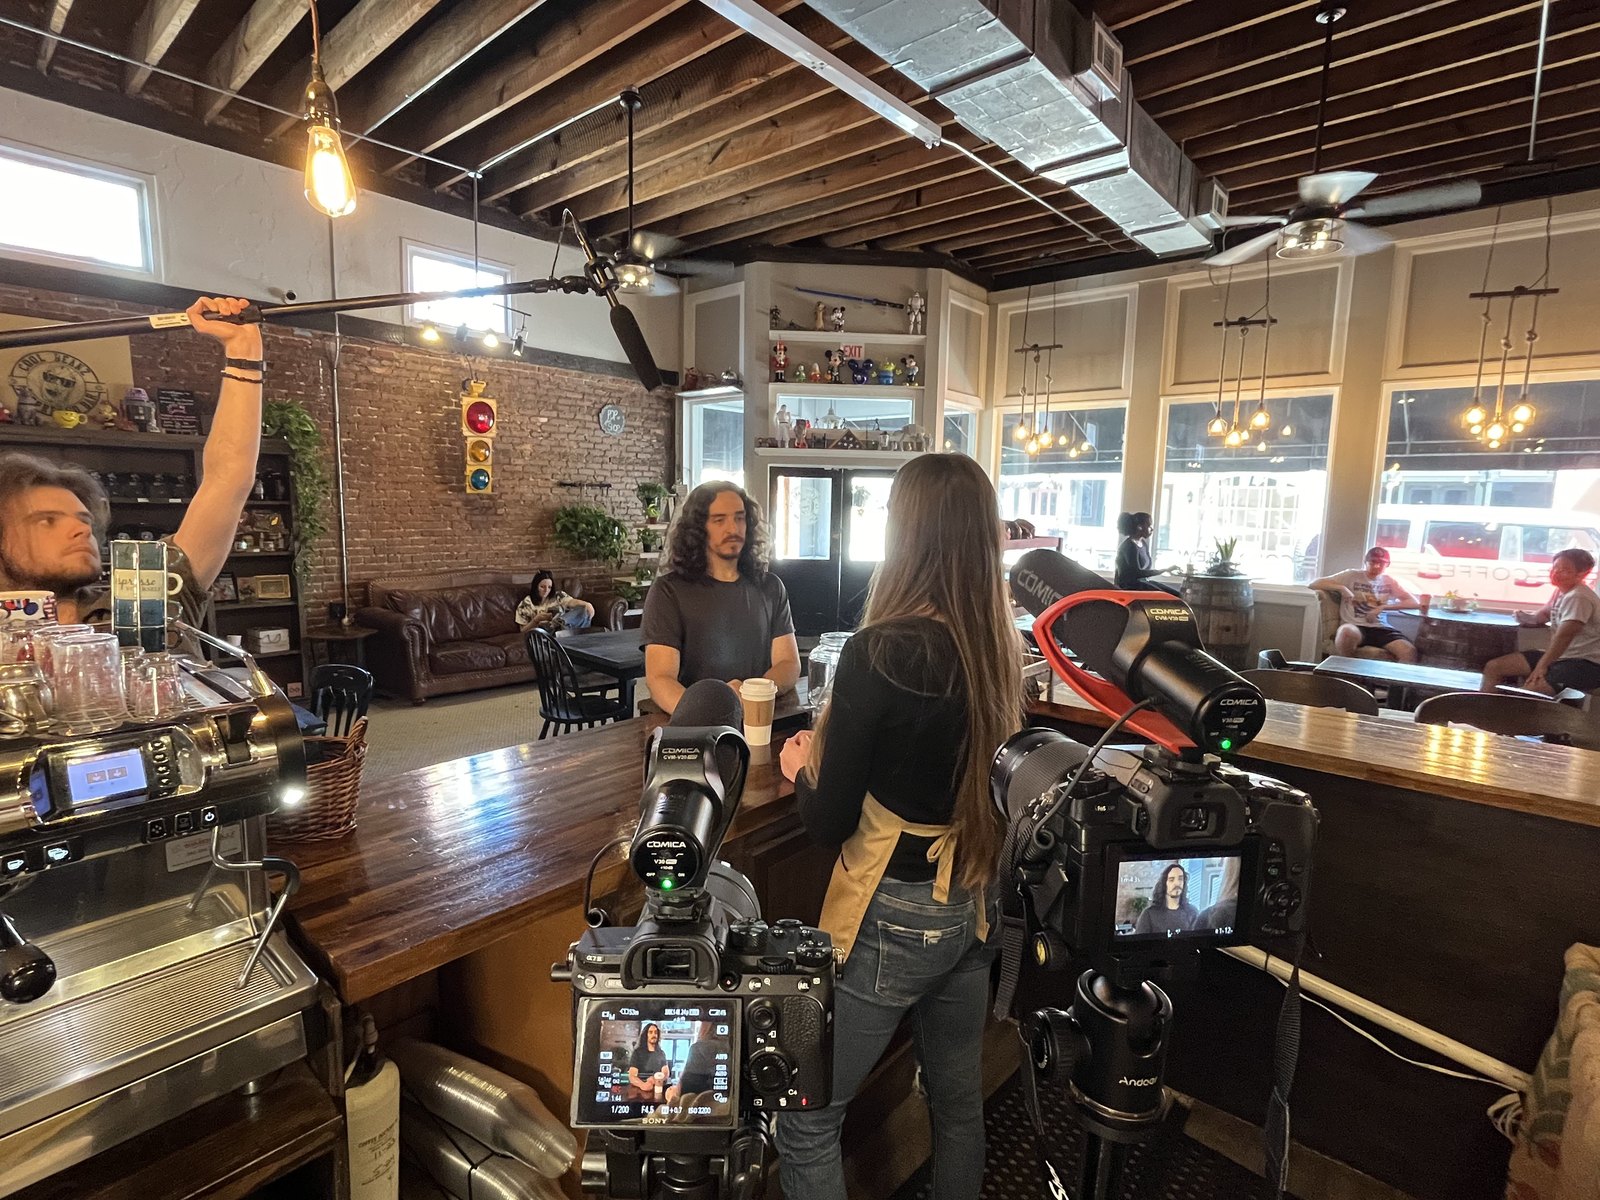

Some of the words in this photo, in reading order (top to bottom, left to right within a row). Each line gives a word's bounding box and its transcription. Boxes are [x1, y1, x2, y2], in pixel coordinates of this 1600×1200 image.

[843, 345, 863, 358] EXIT
[646, 841, 687, 849] COMICA
[611, 1105, 630, 1114] 1/200
[642, 1117, 668, 1125] SONY
